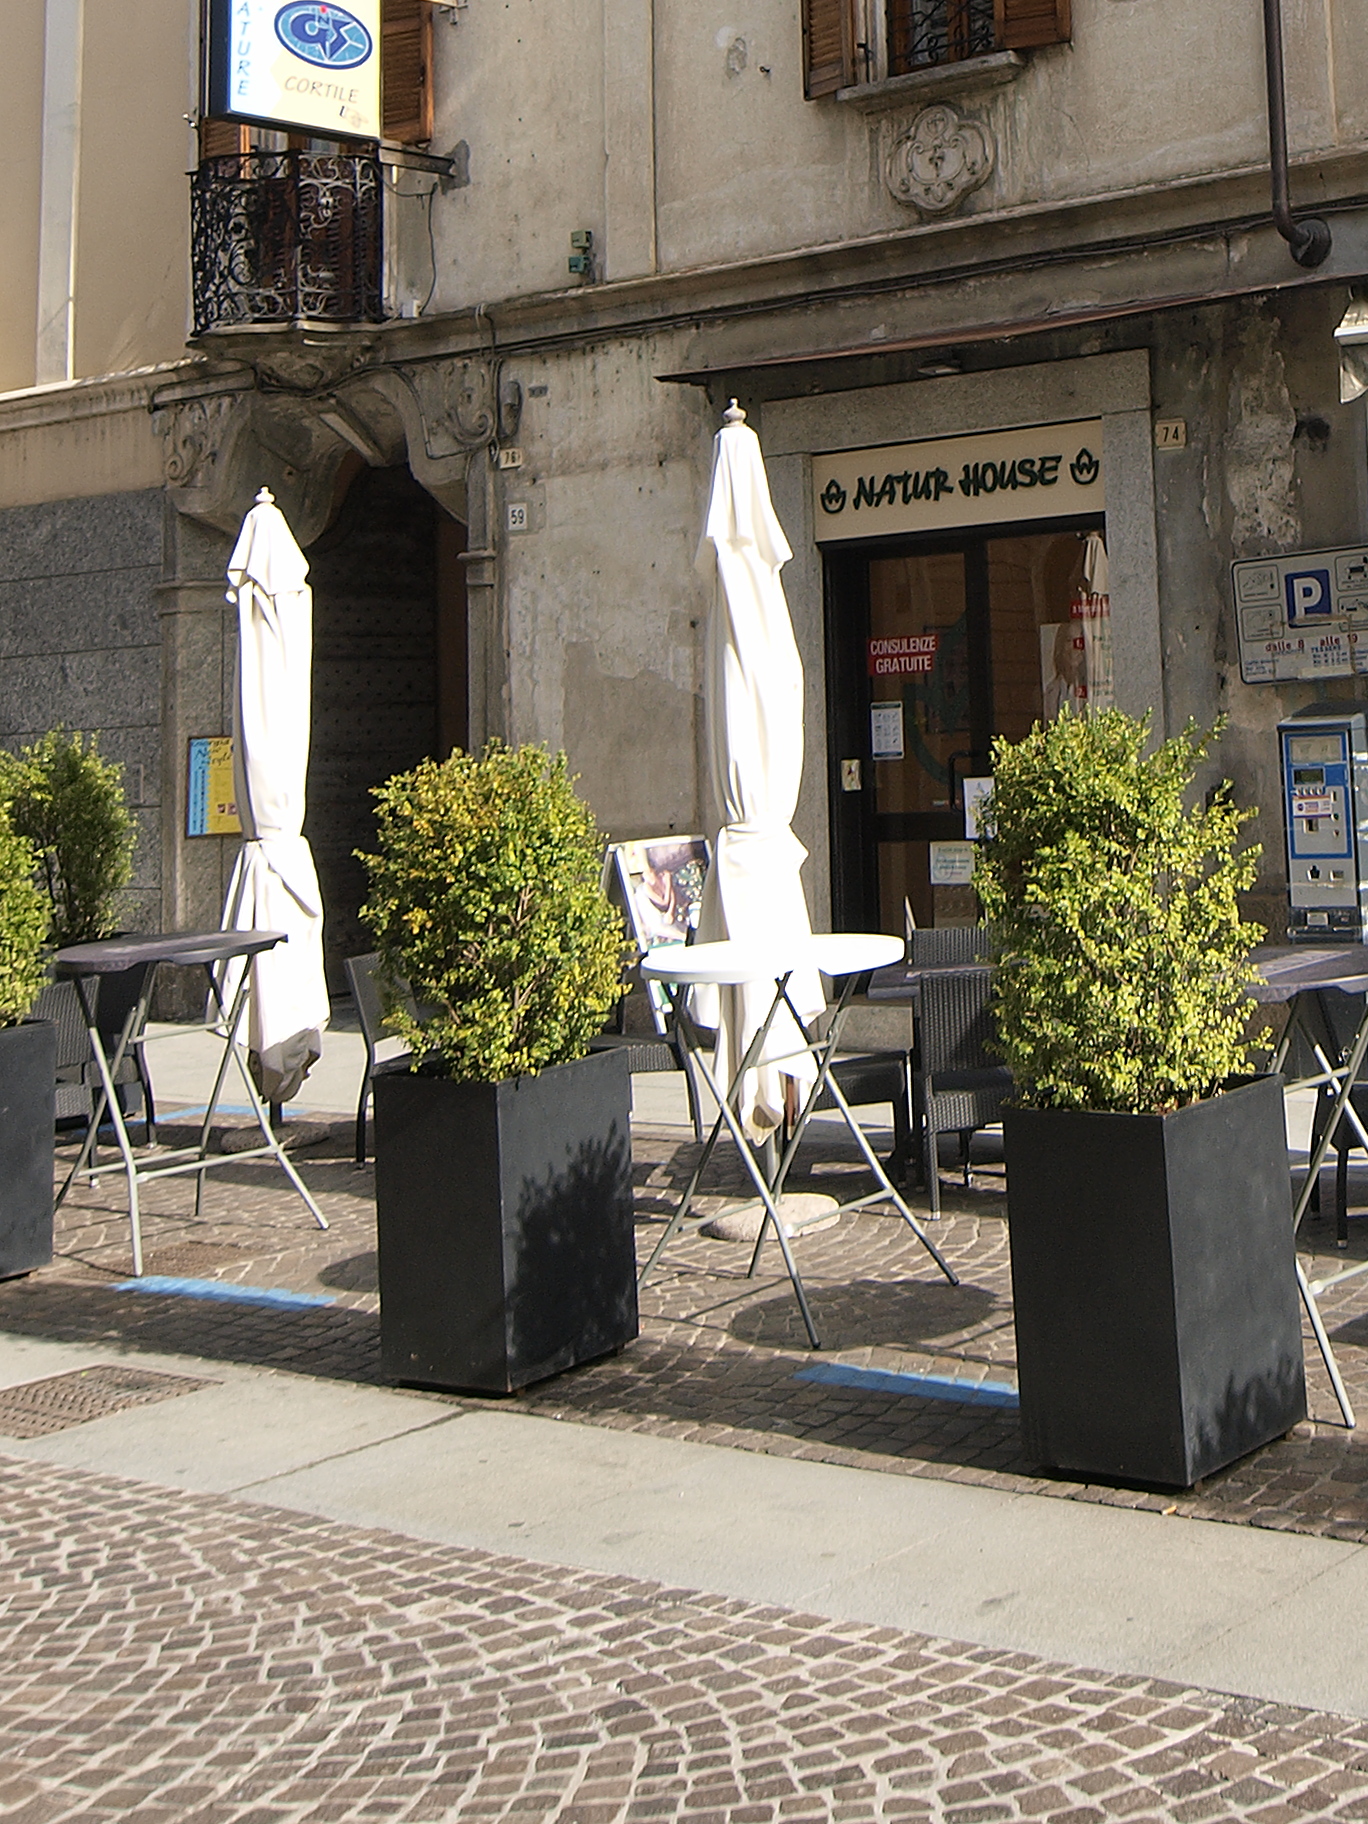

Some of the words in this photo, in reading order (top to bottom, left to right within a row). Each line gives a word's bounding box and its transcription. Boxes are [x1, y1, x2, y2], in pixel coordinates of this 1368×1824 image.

[284, 75, 360, 104] CORTILE
[1162, 425, 1179, 442] 74
[853, 466, 953, 510] NATUR
[959, 454, 1063, 497] HOUSE
[510, 508, 525, 525] 59
[1293, 576, 1322, 618] P
[870, 636, 936, 656] CONSULENZE
[1265, 640, 1291, 652] dalle
[1320, 636, 1340, 647] alle
[876, 655, 932, 674] GRATUITE
